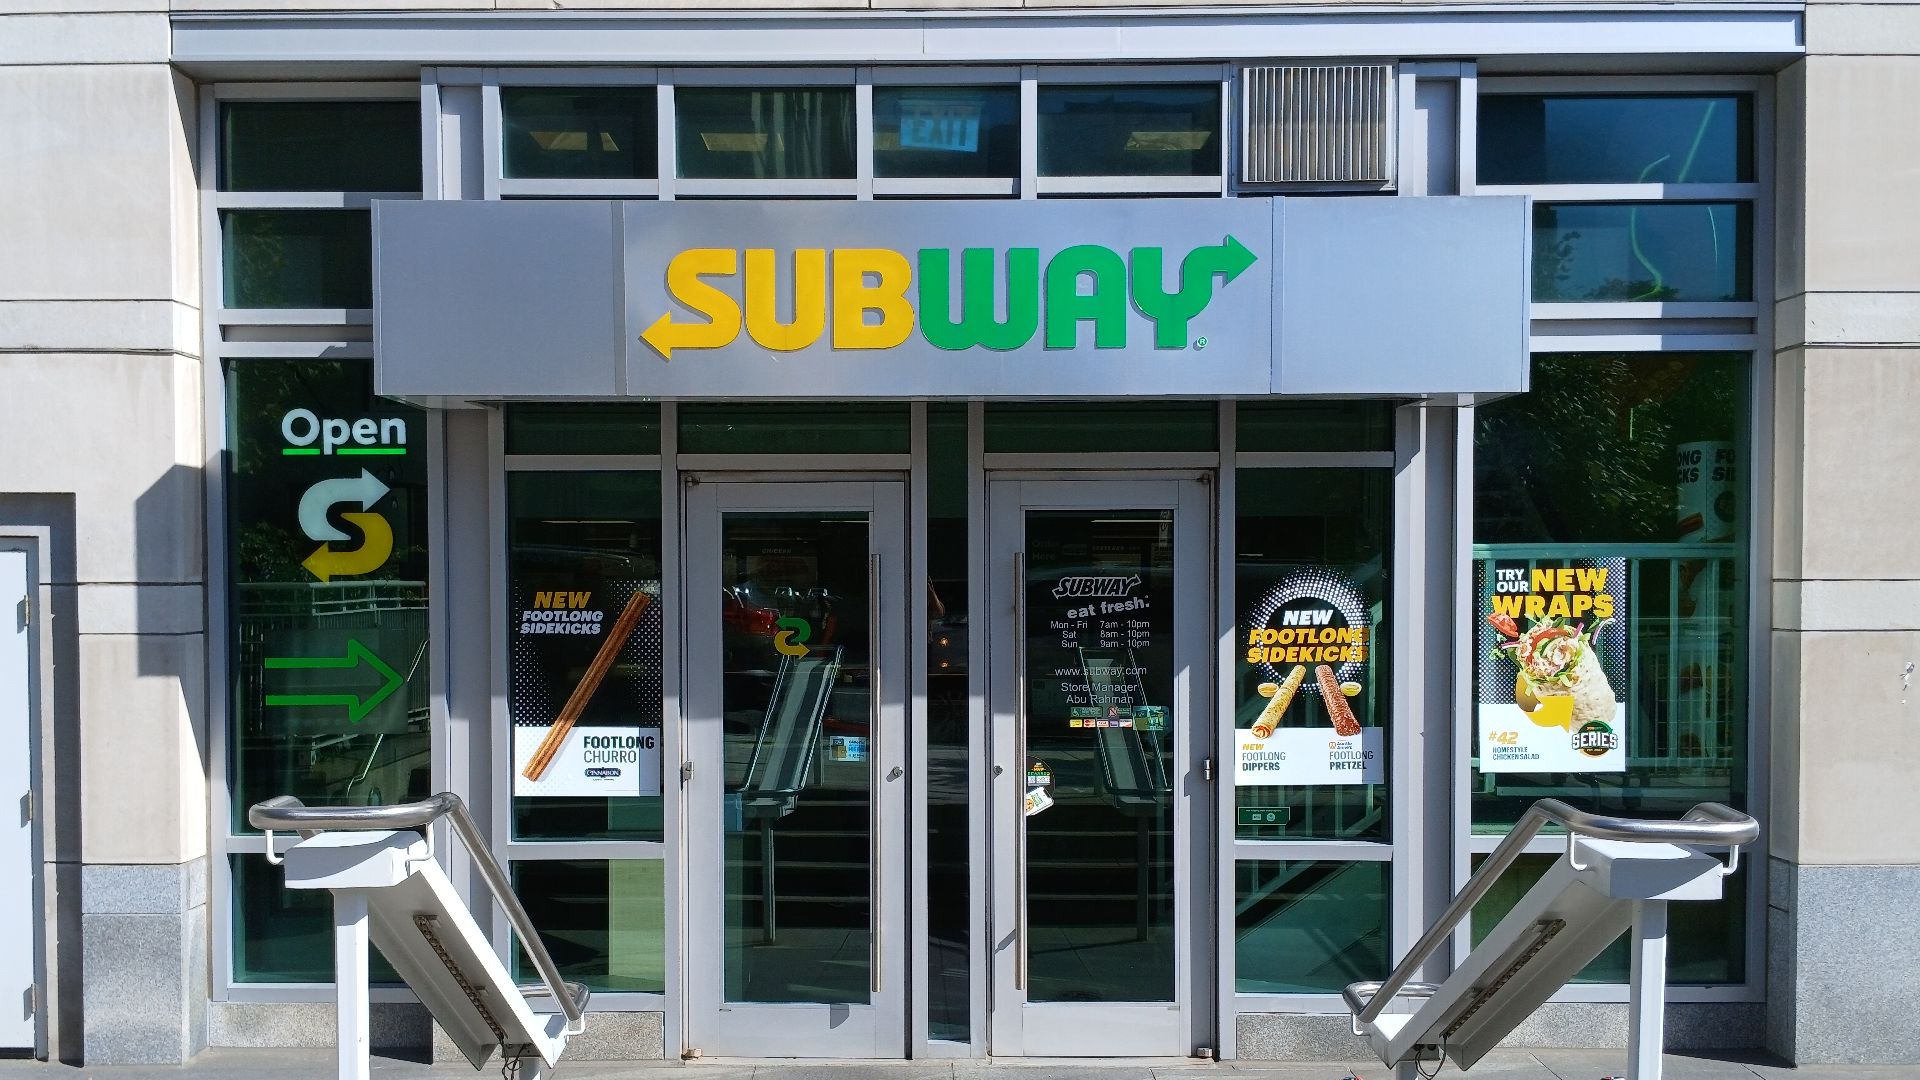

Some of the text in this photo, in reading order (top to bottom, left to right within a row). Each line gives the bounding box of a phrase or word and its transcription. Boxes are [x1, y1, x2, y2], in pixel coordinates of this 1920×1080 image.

[639, 234, 1257, 361] SUBWAY
[281, 408, 407, 456] Open
[1496, 569, 1525, 581] TRY
[1531, 568, 1610, 593] NEW
[1052, 574, 1142, 599] SUBWAY
[1496, 581, 1529, 593] OUR
[534, 591, 591, 609] NEW
[1067, 597, 1150, 619] eat fresh.
[1491, 594, 1615, 619] WRAPS
[522, 611, 604, 622] FOOTLONG
[1283, 610, 1333, 625] NEW
[520, 623, 601, 635] SIDEKICKS
[1051, 621, 1069, 629] Mon
[1077, 621, 1088, 629] Fri
[1100, 621, 1119, 629] 7am
[1127, 621, 1150, 631] 10pm
[1062, 631, 1077, 639] Sat
[1100, 631, 1119, 639] 8am
[1127, 630, 1150, 640] 10pm
[1248, 628, 1370, 645] FOOTLONG
[1061, 640, 1078, 648] Sun
[1100, 640, 1119, 648] 9am
[1127, 640, 1150, 649] 10pm
[1246, 646, 1368, 663] SIDEKICKS
[1054, 666, 1147, 678] www.subway.com
[1061, 683, 1138, 694] Store Manager
[1066, 694, 1134, 704] Abu Rahman
[584, 736, 655, 750] FOOTLONG
[1572, 731, 1618, 750] SERIES
[1242, 743, 1264, 751] NEW
[584, 750, 637, 764] CHURRO
[1242, 751, 1286, 761] FOOTLONG
[1329, 751, 1374, 760] FOOTLONG
[1242, 761, 1281, 771] DIPPERS
[1329, 761, 1368, 771] PRETZEL
